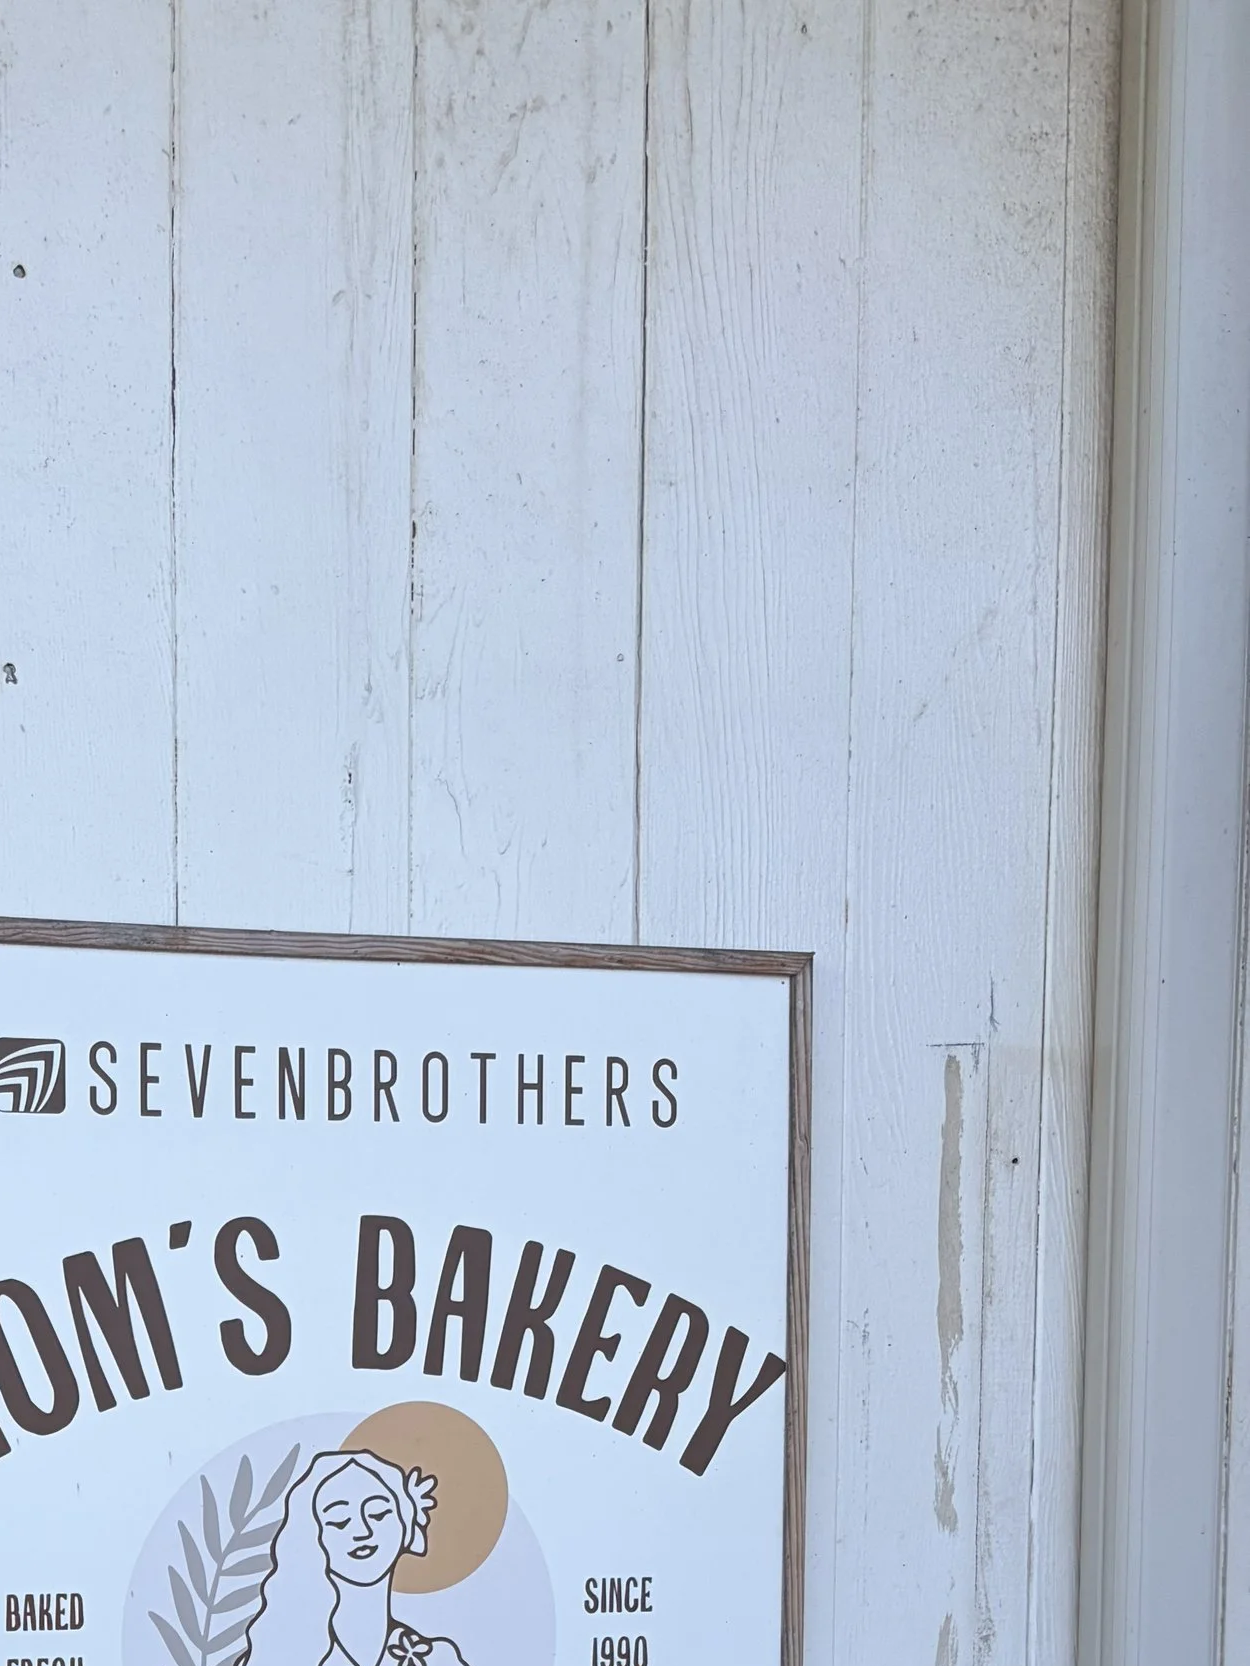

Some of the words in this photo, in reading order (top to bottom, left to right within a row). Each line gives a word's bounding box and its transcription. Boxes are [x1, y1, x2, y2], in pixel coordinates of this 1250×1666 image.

[88, 1039, 679, 1129] SEVENBROTHERS
[350, 1213, 787, 1478] BAKERY
[4, 1592, 85, 1632] BAKED
[583, 1575, 654, 1614] SINCE
